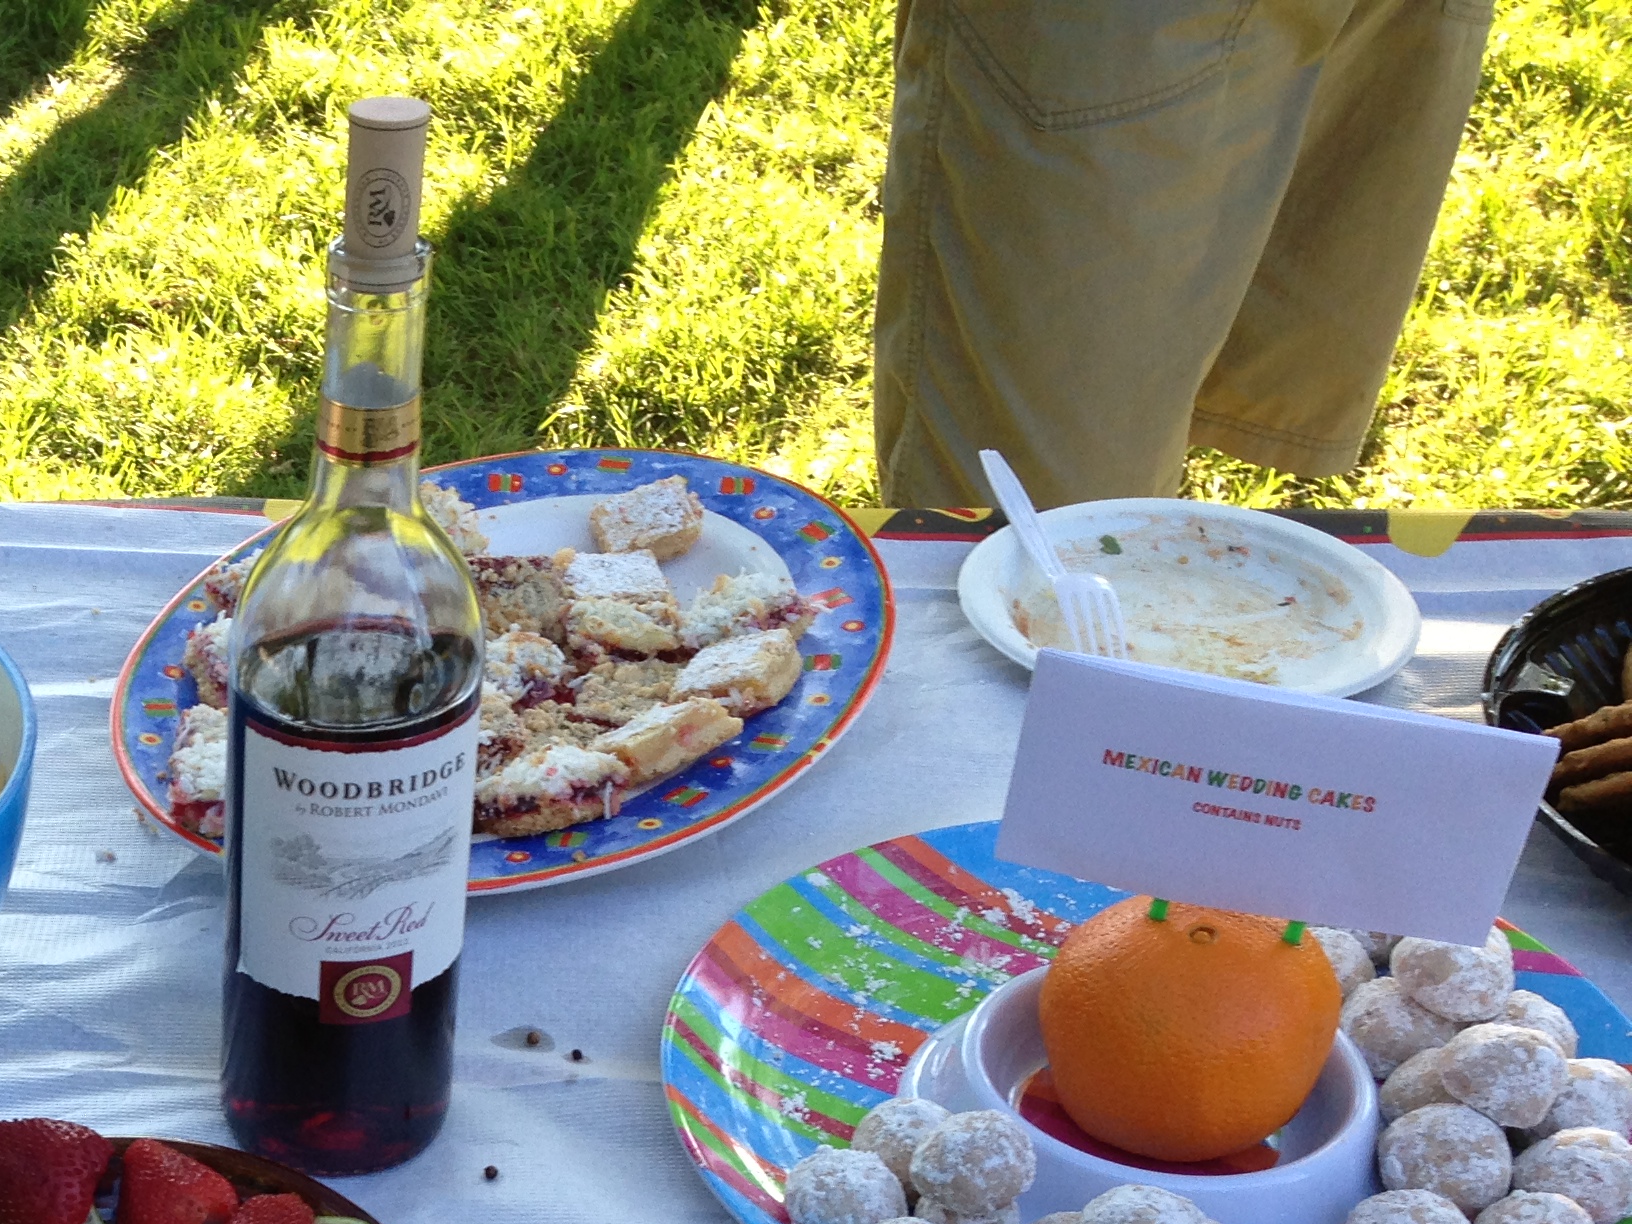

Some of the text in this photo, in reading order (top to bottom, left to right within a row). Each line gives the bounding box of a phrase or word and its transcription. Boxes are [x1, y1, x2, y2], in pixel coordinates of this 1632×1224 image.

[272, 752, 465, 799] WOODBRIDGE
[1102, 748, 1377, 813] MEXICAN WEDDING CAKES
[309, 803, 373, 818] ROBERT
[377, 786, 449, 816] MONDAVI
[1192, 801, 1302, 831] CONTAINS NUTS
[288, 901, 436, 942] Sweet Red
